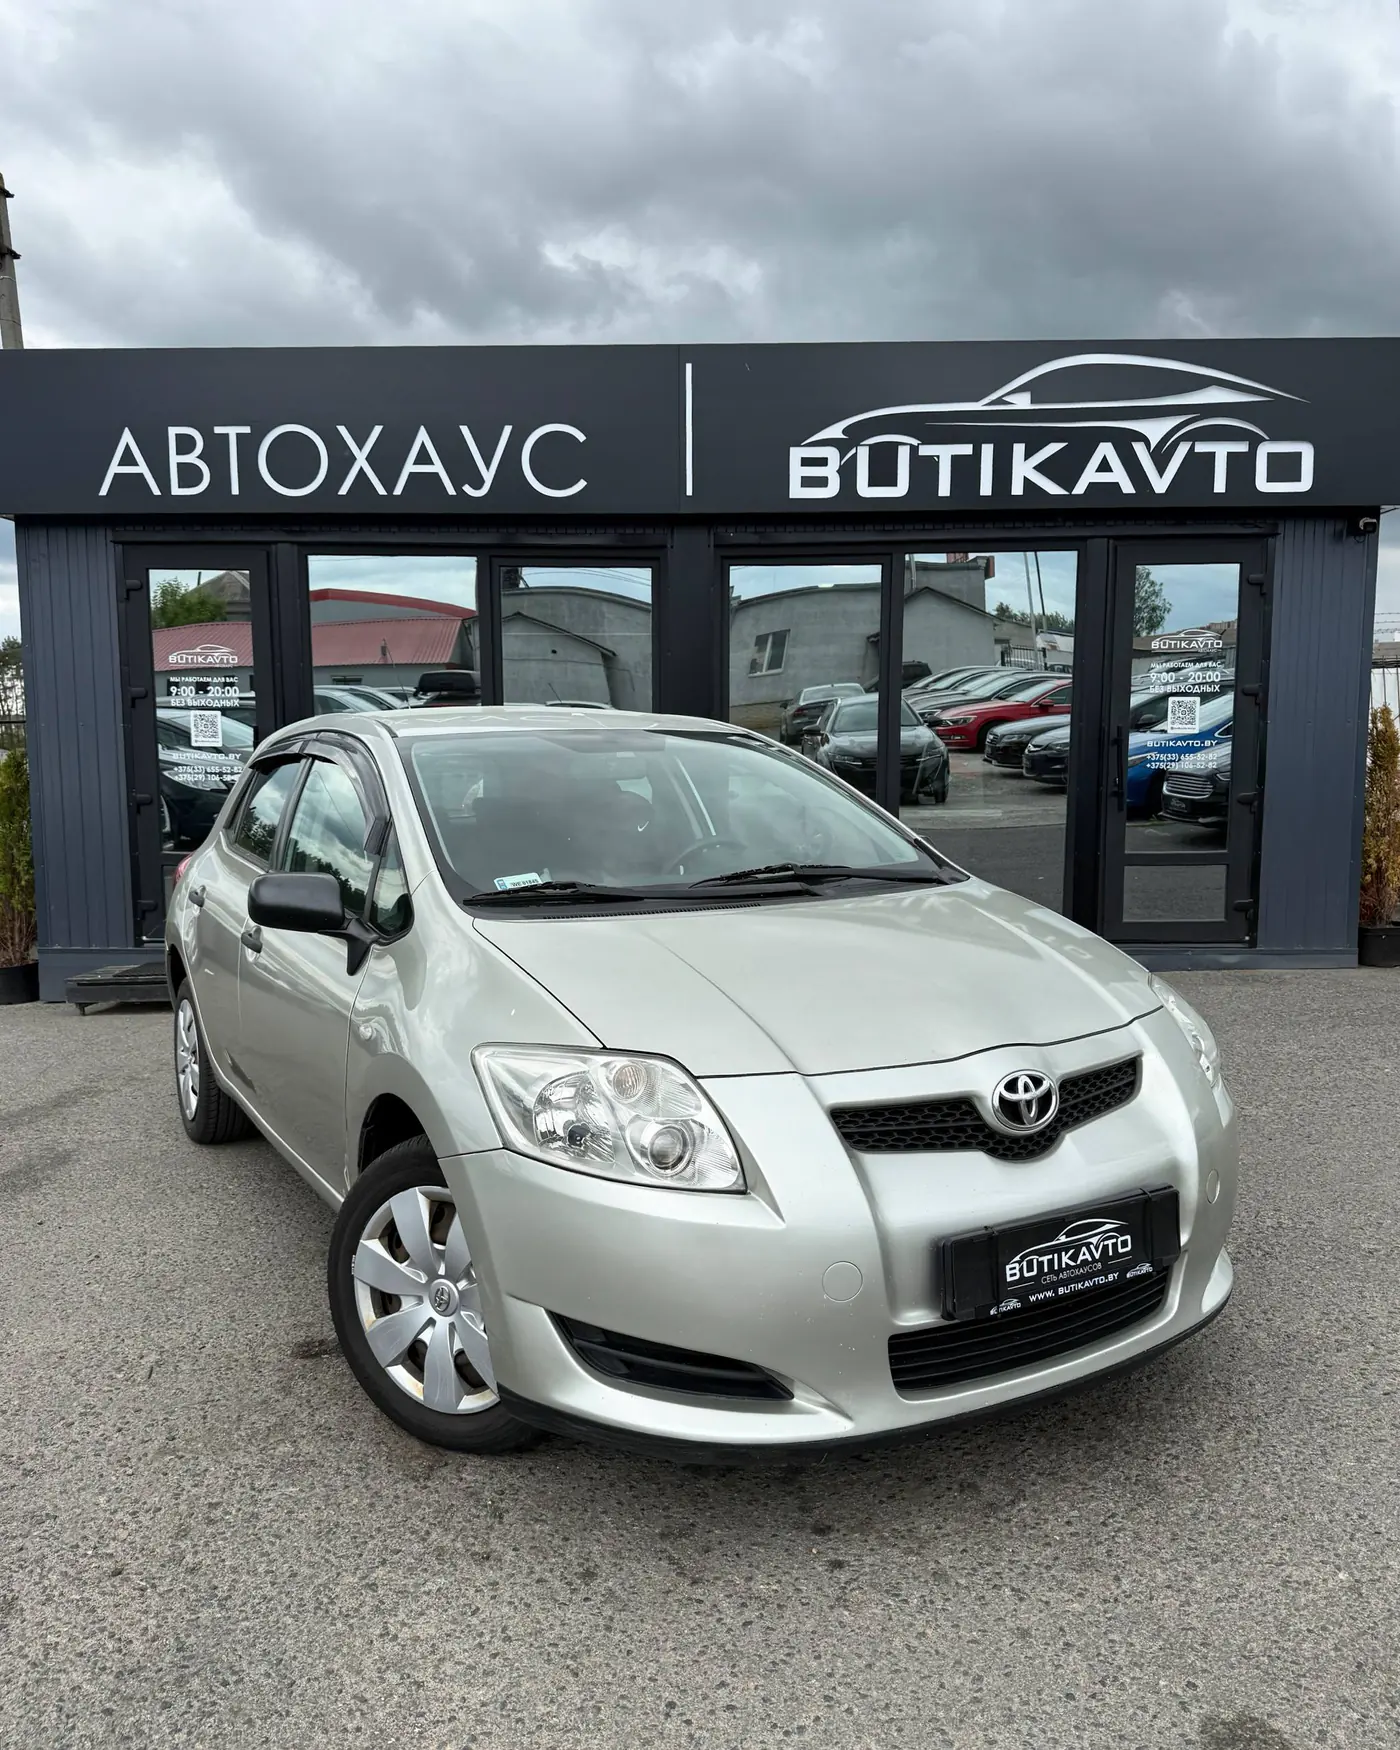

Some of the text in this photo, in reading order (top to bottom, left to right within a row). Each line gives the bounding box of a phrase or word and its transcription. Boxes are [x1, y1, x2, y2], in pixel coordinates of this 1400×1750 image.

[98, 423, 588, 497] АВТОХАУС
[789, 440, 1314, 499] BUTIKAVTO
[1151, 640, 1223, 649] BUTIKAVTO
[168, 655, 238, 664] BUTIKAVTO
[1150, 672, 1176, 683] 9:00
[1188, 672, 1221, 683] 20:00
[170, 686, 196, 697] 9:00
[207, 686, 240, 697] 20:00
[1149, 684, 1221, 693] БЕЗ ВЫХОДНЫХ
[171, 699, 240, 708] БЕЗ ВЫХОДНЫХ
[1005, 1234, 1132, 1282] BUTIKAVTO
[1041, 1262, 1102, 1284] СЕТЬ АВТОХАУСОВ
[1029, 1272, 1119, 1303] WWW. BUTIKAVTO.BY
